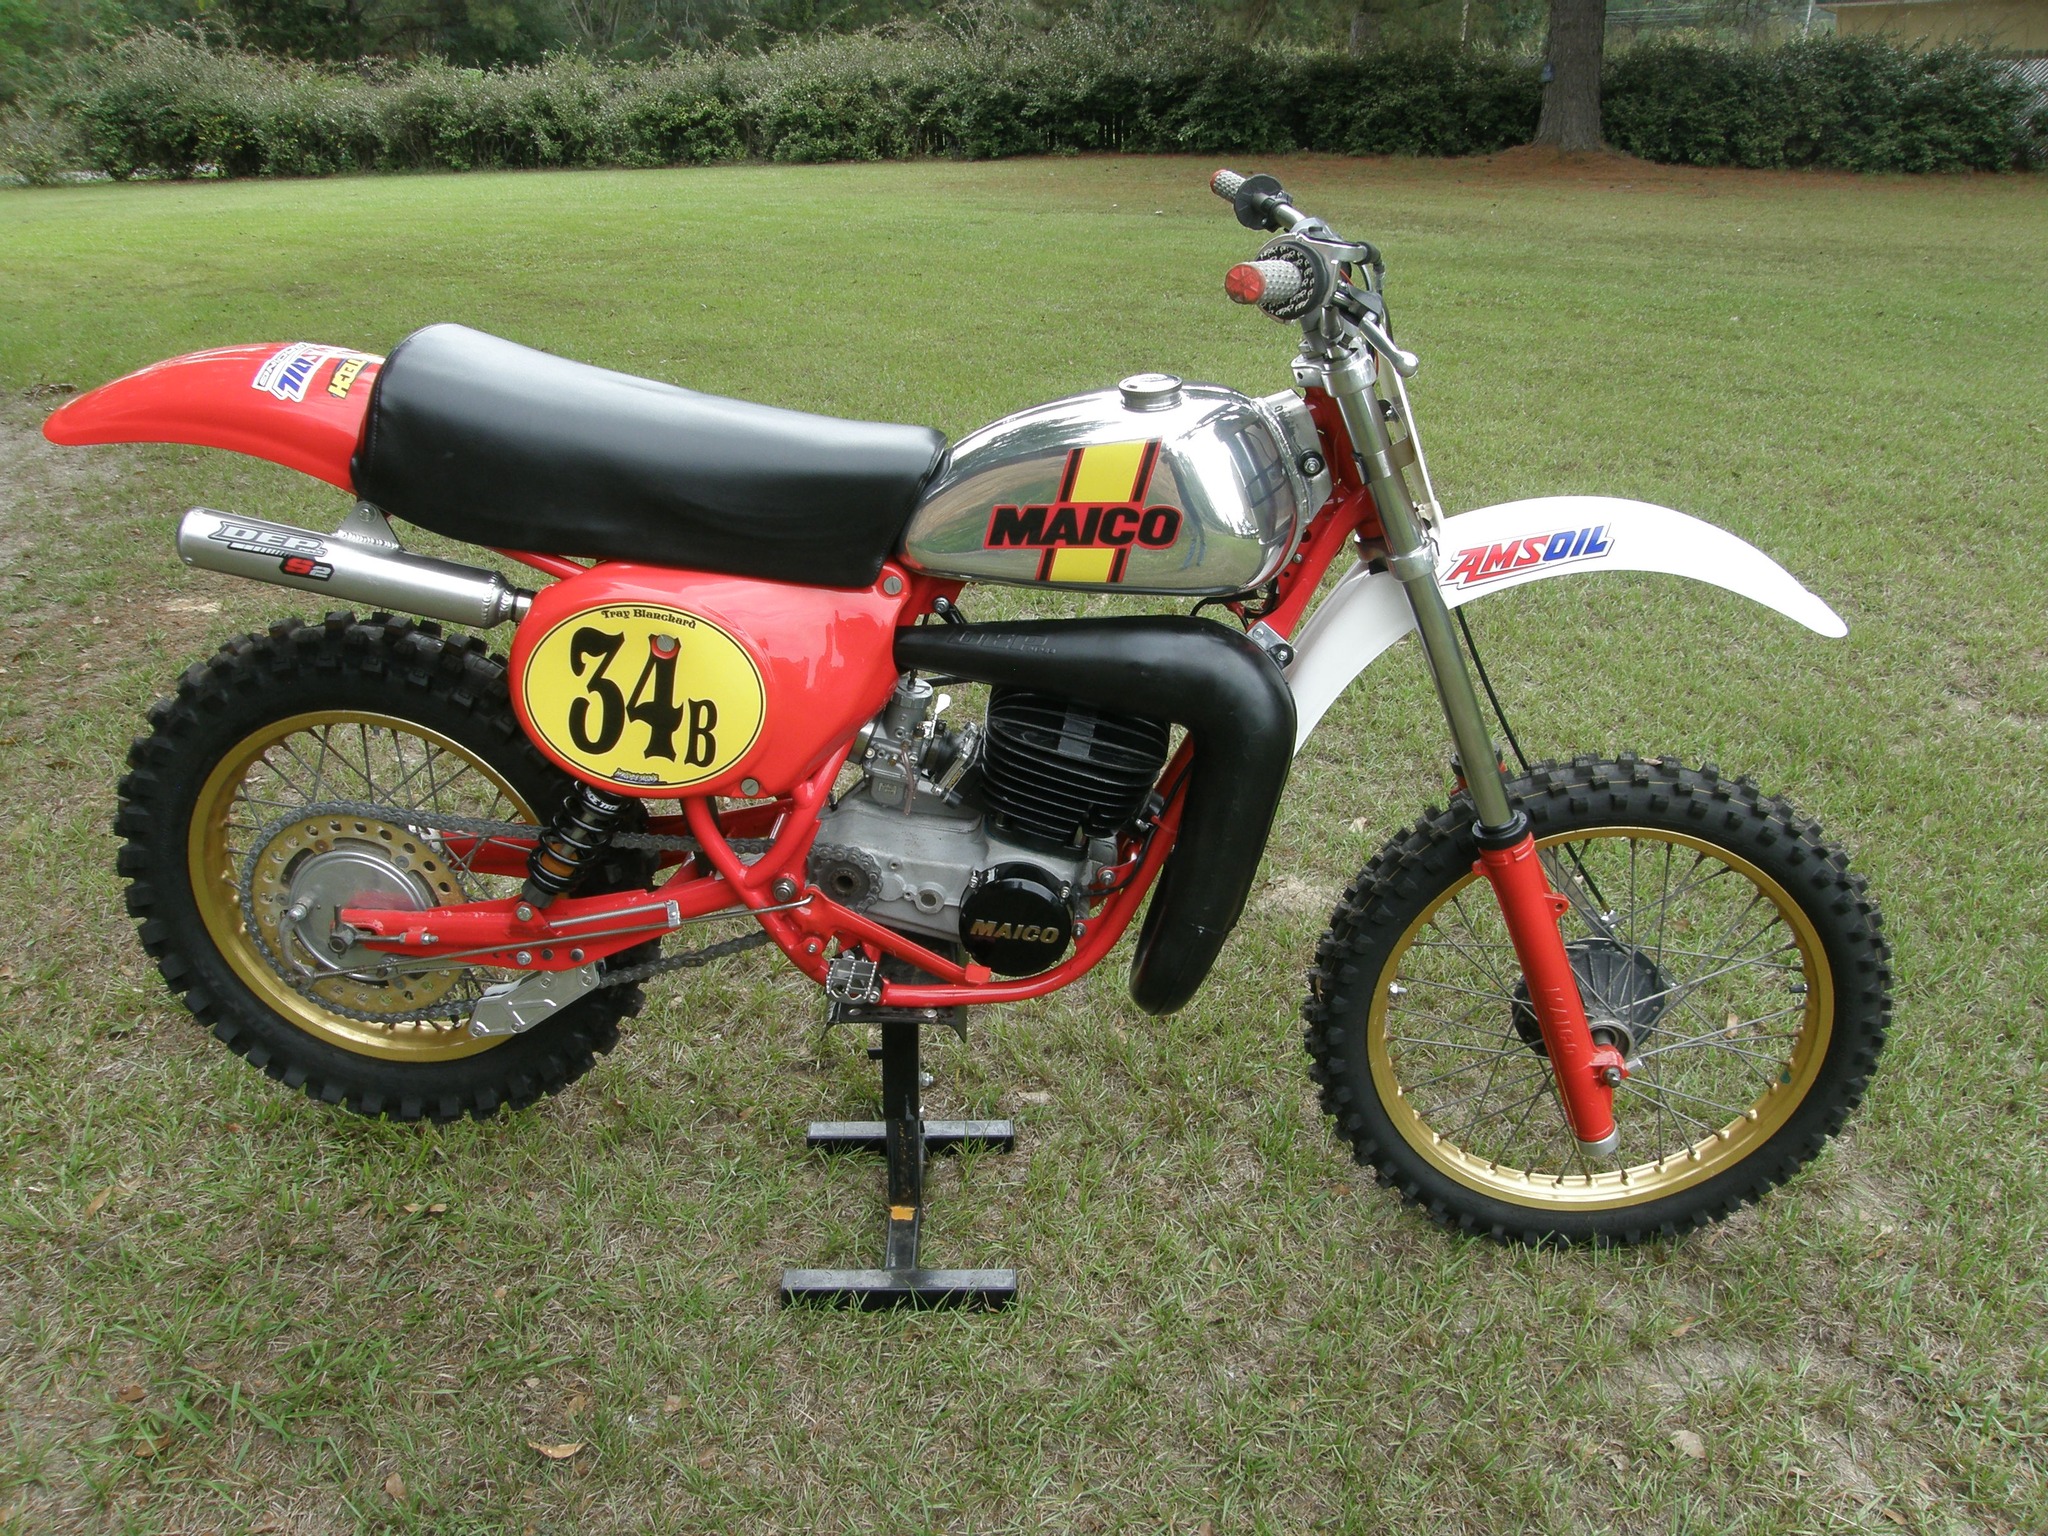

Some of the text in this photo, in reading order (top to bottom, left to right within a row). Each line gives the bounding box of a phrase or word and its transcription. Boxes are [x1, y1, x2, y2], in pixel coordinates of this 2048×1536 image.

[221, 525, 322, 550] DEP
[987, 506, 1181, 547] MAICO
[1446, 525, 1608, 584] AMSOIL
[284, 557, 332, 579] S2
[601, 609, 697, 629] Tray Blanchard
[969, 918, 1060, 944] MAICO
